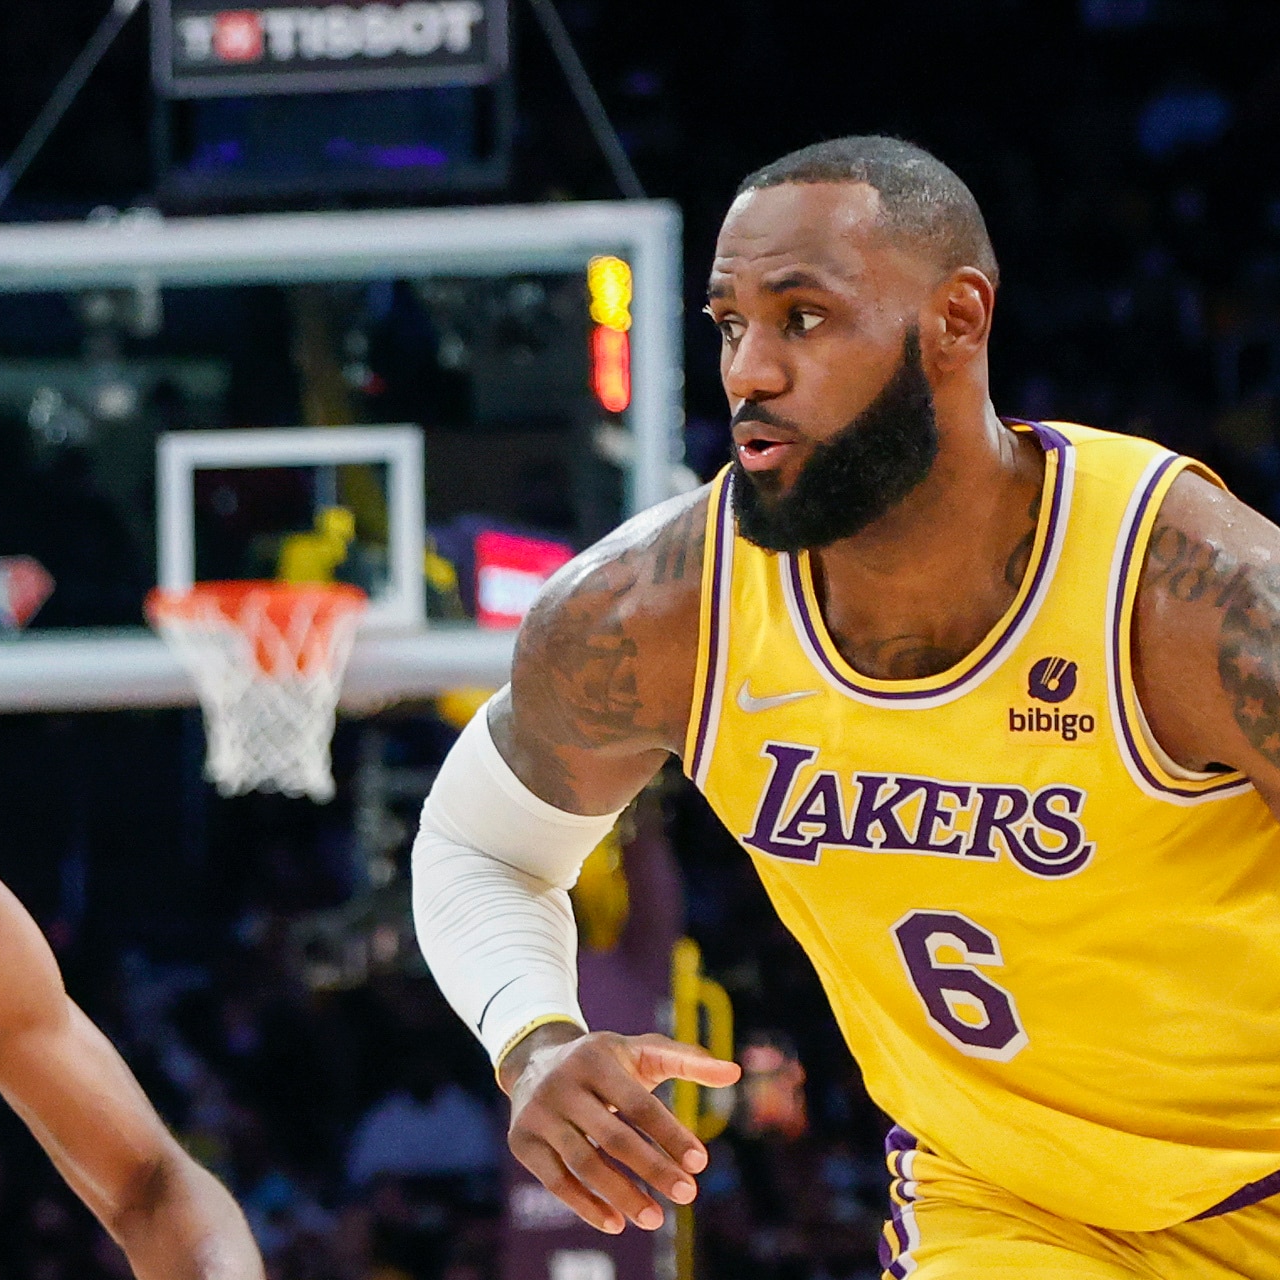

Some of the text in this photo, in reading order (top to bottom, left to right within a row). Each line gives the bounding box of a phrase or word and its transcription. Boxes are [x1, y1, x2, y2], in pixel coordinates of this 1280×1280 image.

[266, 1, 486, 61] TISSOT
[1008, 708, 1096, 741] bibigo
[741, 740, 1098, 880] LAKERS
[888, 908, 1030, 1064] 6
